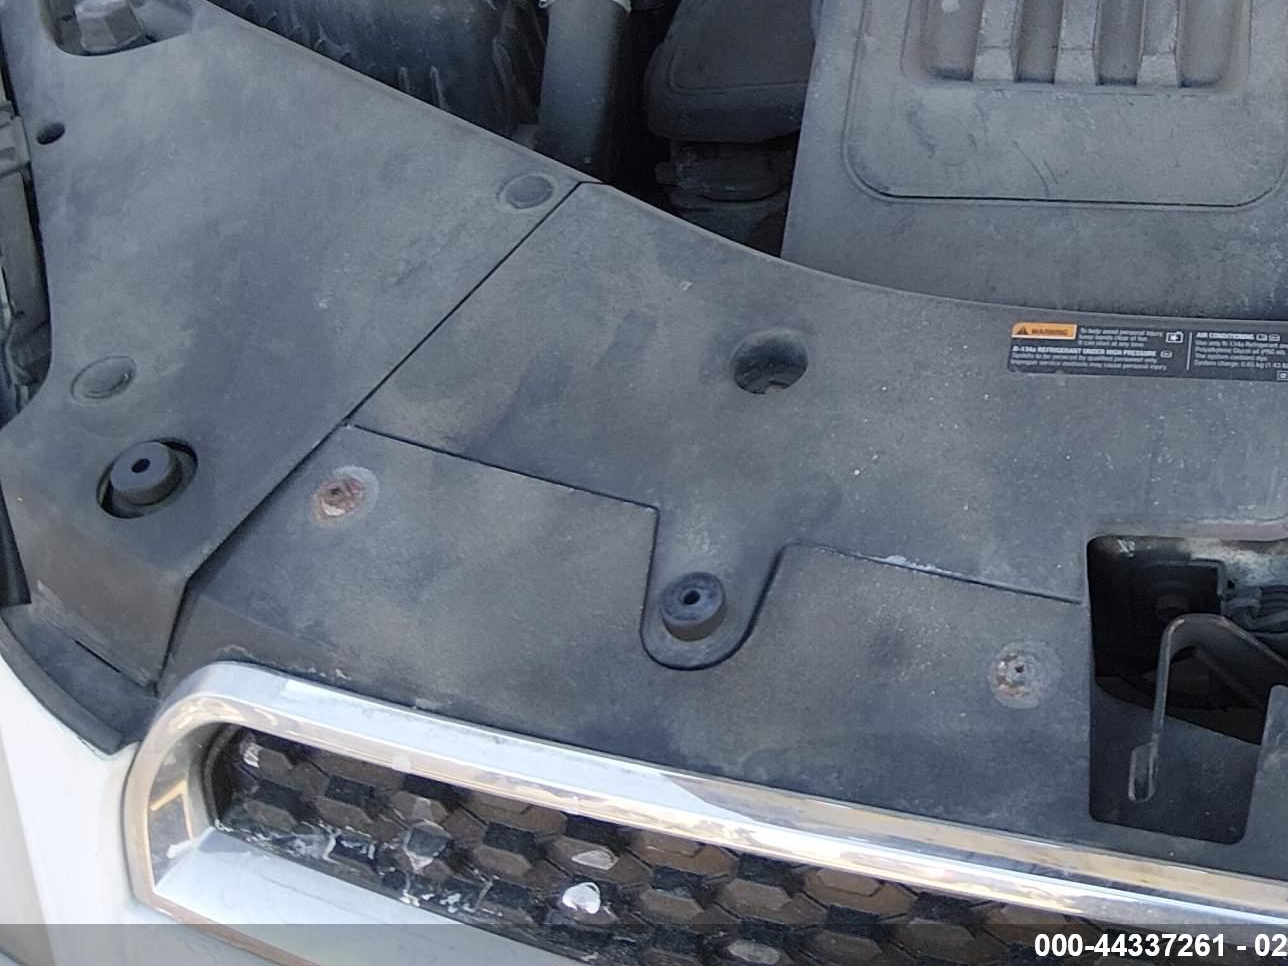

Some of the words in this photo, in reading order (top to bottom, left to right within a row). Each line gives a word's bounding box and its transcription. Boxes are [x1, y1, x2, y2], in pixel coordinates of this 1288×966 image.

[1037, 346, 1081, 354] REFRIGERANT
[1083, 348, 1105, 356] UNDER
[1106, 349, 1122, 357] HIGH
[1123, 350, 1156, 358] PRESSURE
